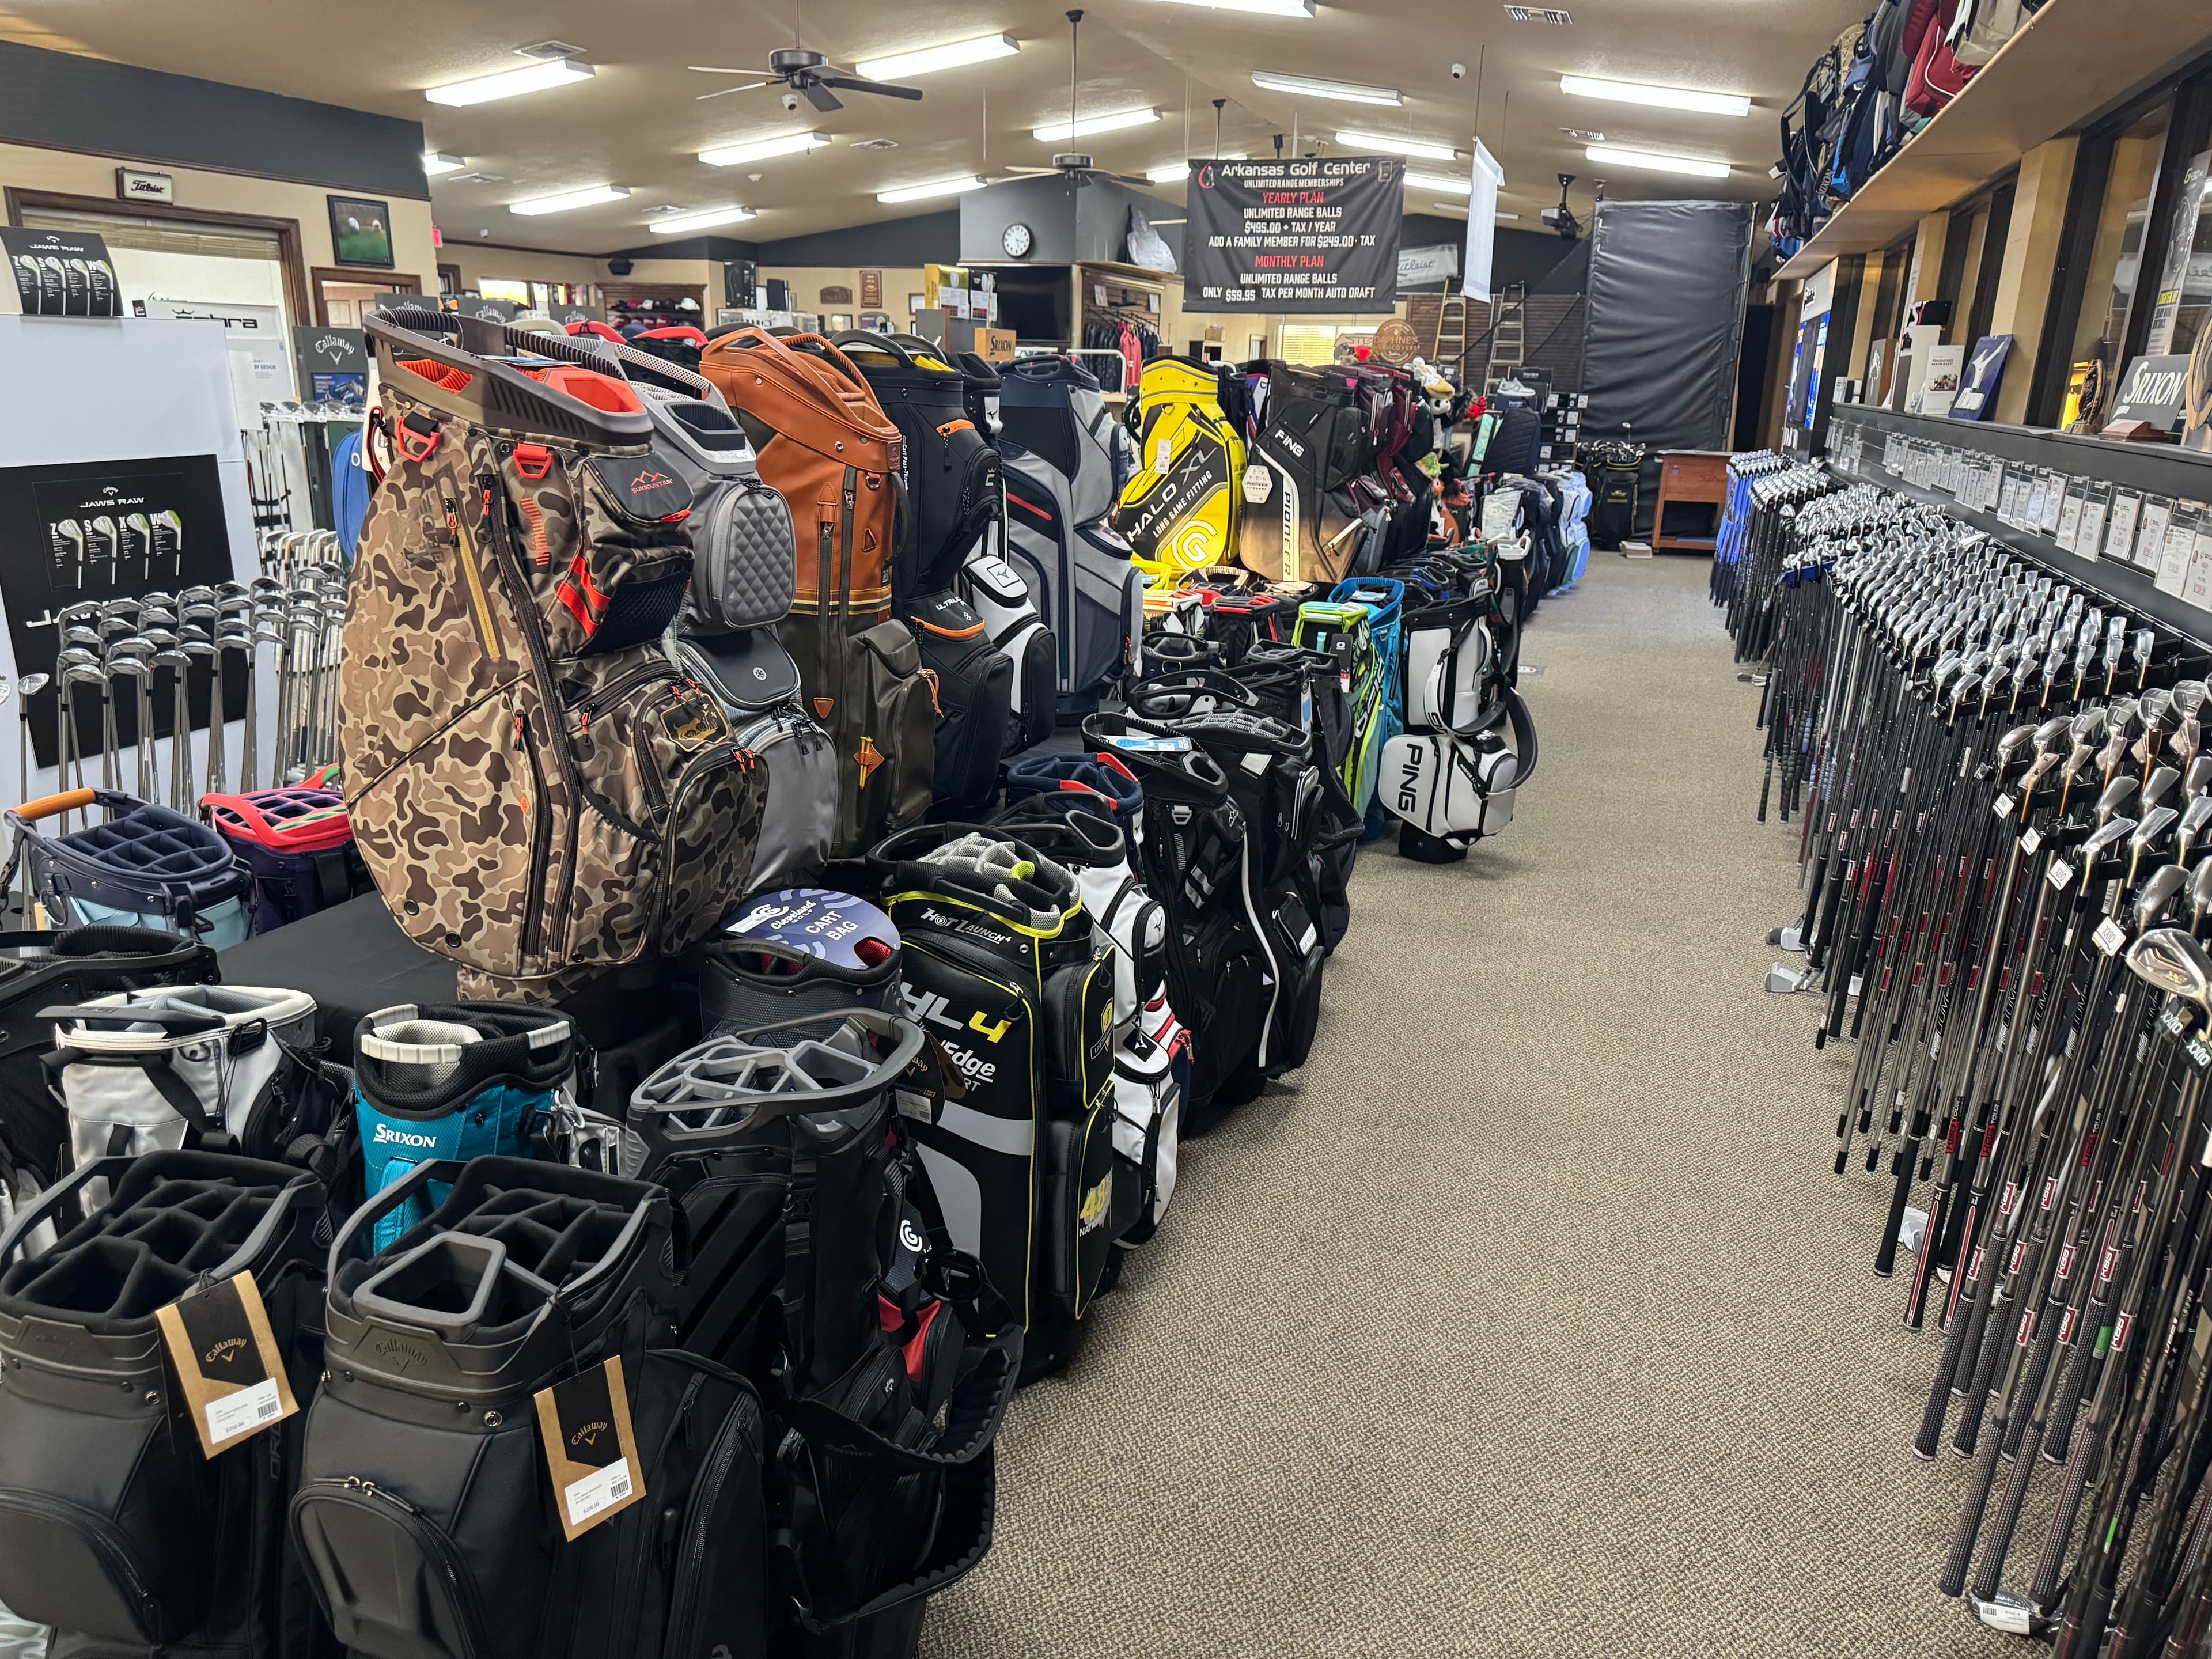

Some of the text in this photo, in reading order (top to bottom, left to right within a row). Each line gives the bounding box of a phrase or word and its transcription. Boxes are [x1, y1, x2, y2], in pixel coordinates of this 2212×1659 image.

[1221, 161, 1371, 177] Arkansas Golf Center
[1244, 178, 1344, 188] UNLIMITED RANGE MEMBERSHIPS
[1262, 192, 1324, 204] YEARLY PLAN
[1244, 207, 1342, 219] UNLIMITED RANGE BALLS
[1244, 221, 1281, 234] $495.00
[1291, 222, 1306, 233] TAX
[1308, 222, 1313, 233] /
[1315, 221, 1336, 233] YEAR
[1208, 236, 1224, 247] ADD
[1226, 236, 1232, 247] A
[1234, 236, 1262, 247] FAMILY
[1263, 236, 1298, 247] MEMBER
[1300, 236, 1316, 247] FOR
[1317, 235, 1354, 248] $249.00
[1360, 235, 1376, 246] TAX
[37, 257, 46, 268] S
[1255, 255, 1324, 267] MONTHLY PLAN
[1398, 259, 1434, 272] itleist
[1240, 273, 1338, 284] UNLIMITED RANGE BALLS
[1203, 287, 1376, 302] ONLY $59.95 TAX PER MONTH AUTO DRAFT
[315, 334, 355, 355] Callaway
[2122, 361, 2189, 406] SRIXON
[1275, 429, 1305, 457] PING
[79, 499, 115, 508] JAWS
[1127, 482, 1177, 543] HALO
[1152, 470, 1213, 539] LONG GAME FITTING
[50, 522, 58, 536] Z
[84, 519, 93, 532] S
[118, 516, 127, 529] X
[149, 513, 161, 526] W
[1397, 743, 1423, 813] PING
[2055, 868, 2067, 882] XXIO
[771, 900, 816, 929] Cleveland
[805, 910, 842, 933] CART
[921, 907, 959, 927] HOT
[825, 921, 859, 940] BAG
[2101, 925, 2116, 944] XXIO
[969, 1010, 1012, 1043] 4
[2160, 1009, 2184, 1035] XXIO
[941, 1039, 997, 1083] Edge
[2187, 1039, 2211, 1066] XXIO
[1990, 1103, 2001, 1124] TOUR
[2092, 1112, 2103, 1134] TOUR
[375, 1123, 437, 1148] SRIXON
[1999, 1184, 2015, 1213] KBS
[2041, 1181, 2053, 1209] KBS
[1967, 1249, 1979, 1278] KBS
[2008, 1244, 2021, 1271] KBS
[2058, 1247, 2071, 1275] KBS
[2100, 1251, 2113, 1279] KBS
[2017, 1313, 2029, 1343] KBS
[2058, 1312, 2071, 1343] KBS
[2111, 1315, 2125, 1349] KBS
[205, 1338, 247, 1362] Callaway
[375, 1337, 428, 1366] Callaway
[571, 1421, 608, 1445] Callaway
